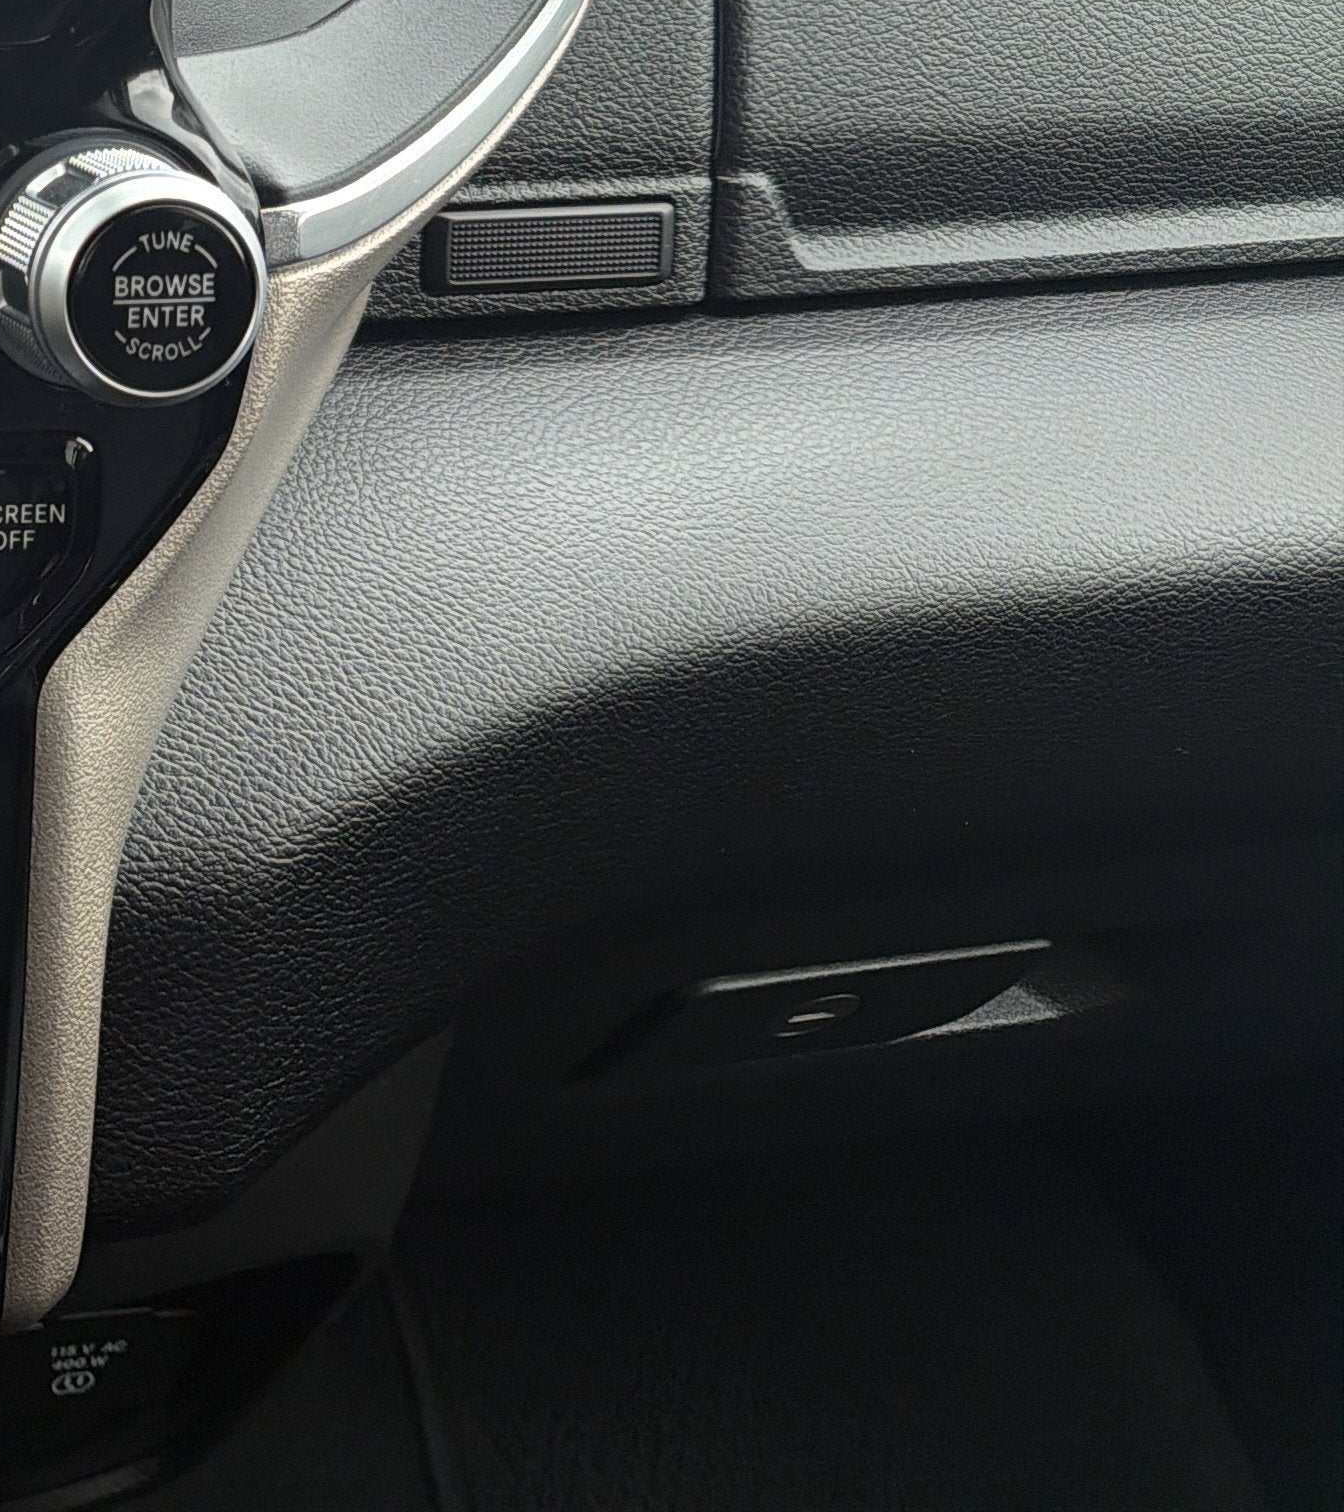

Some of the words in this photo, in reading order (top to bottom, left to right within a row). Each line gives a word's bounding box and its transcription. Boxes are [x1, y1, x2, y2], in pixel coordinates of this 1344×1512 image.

[138, 231, 195, 254] TUNE
[114, 272, 216, 298] BROWSE
[127, 304, 205, 329] ENTER
[125, 335, 202, 362] SCROLL
